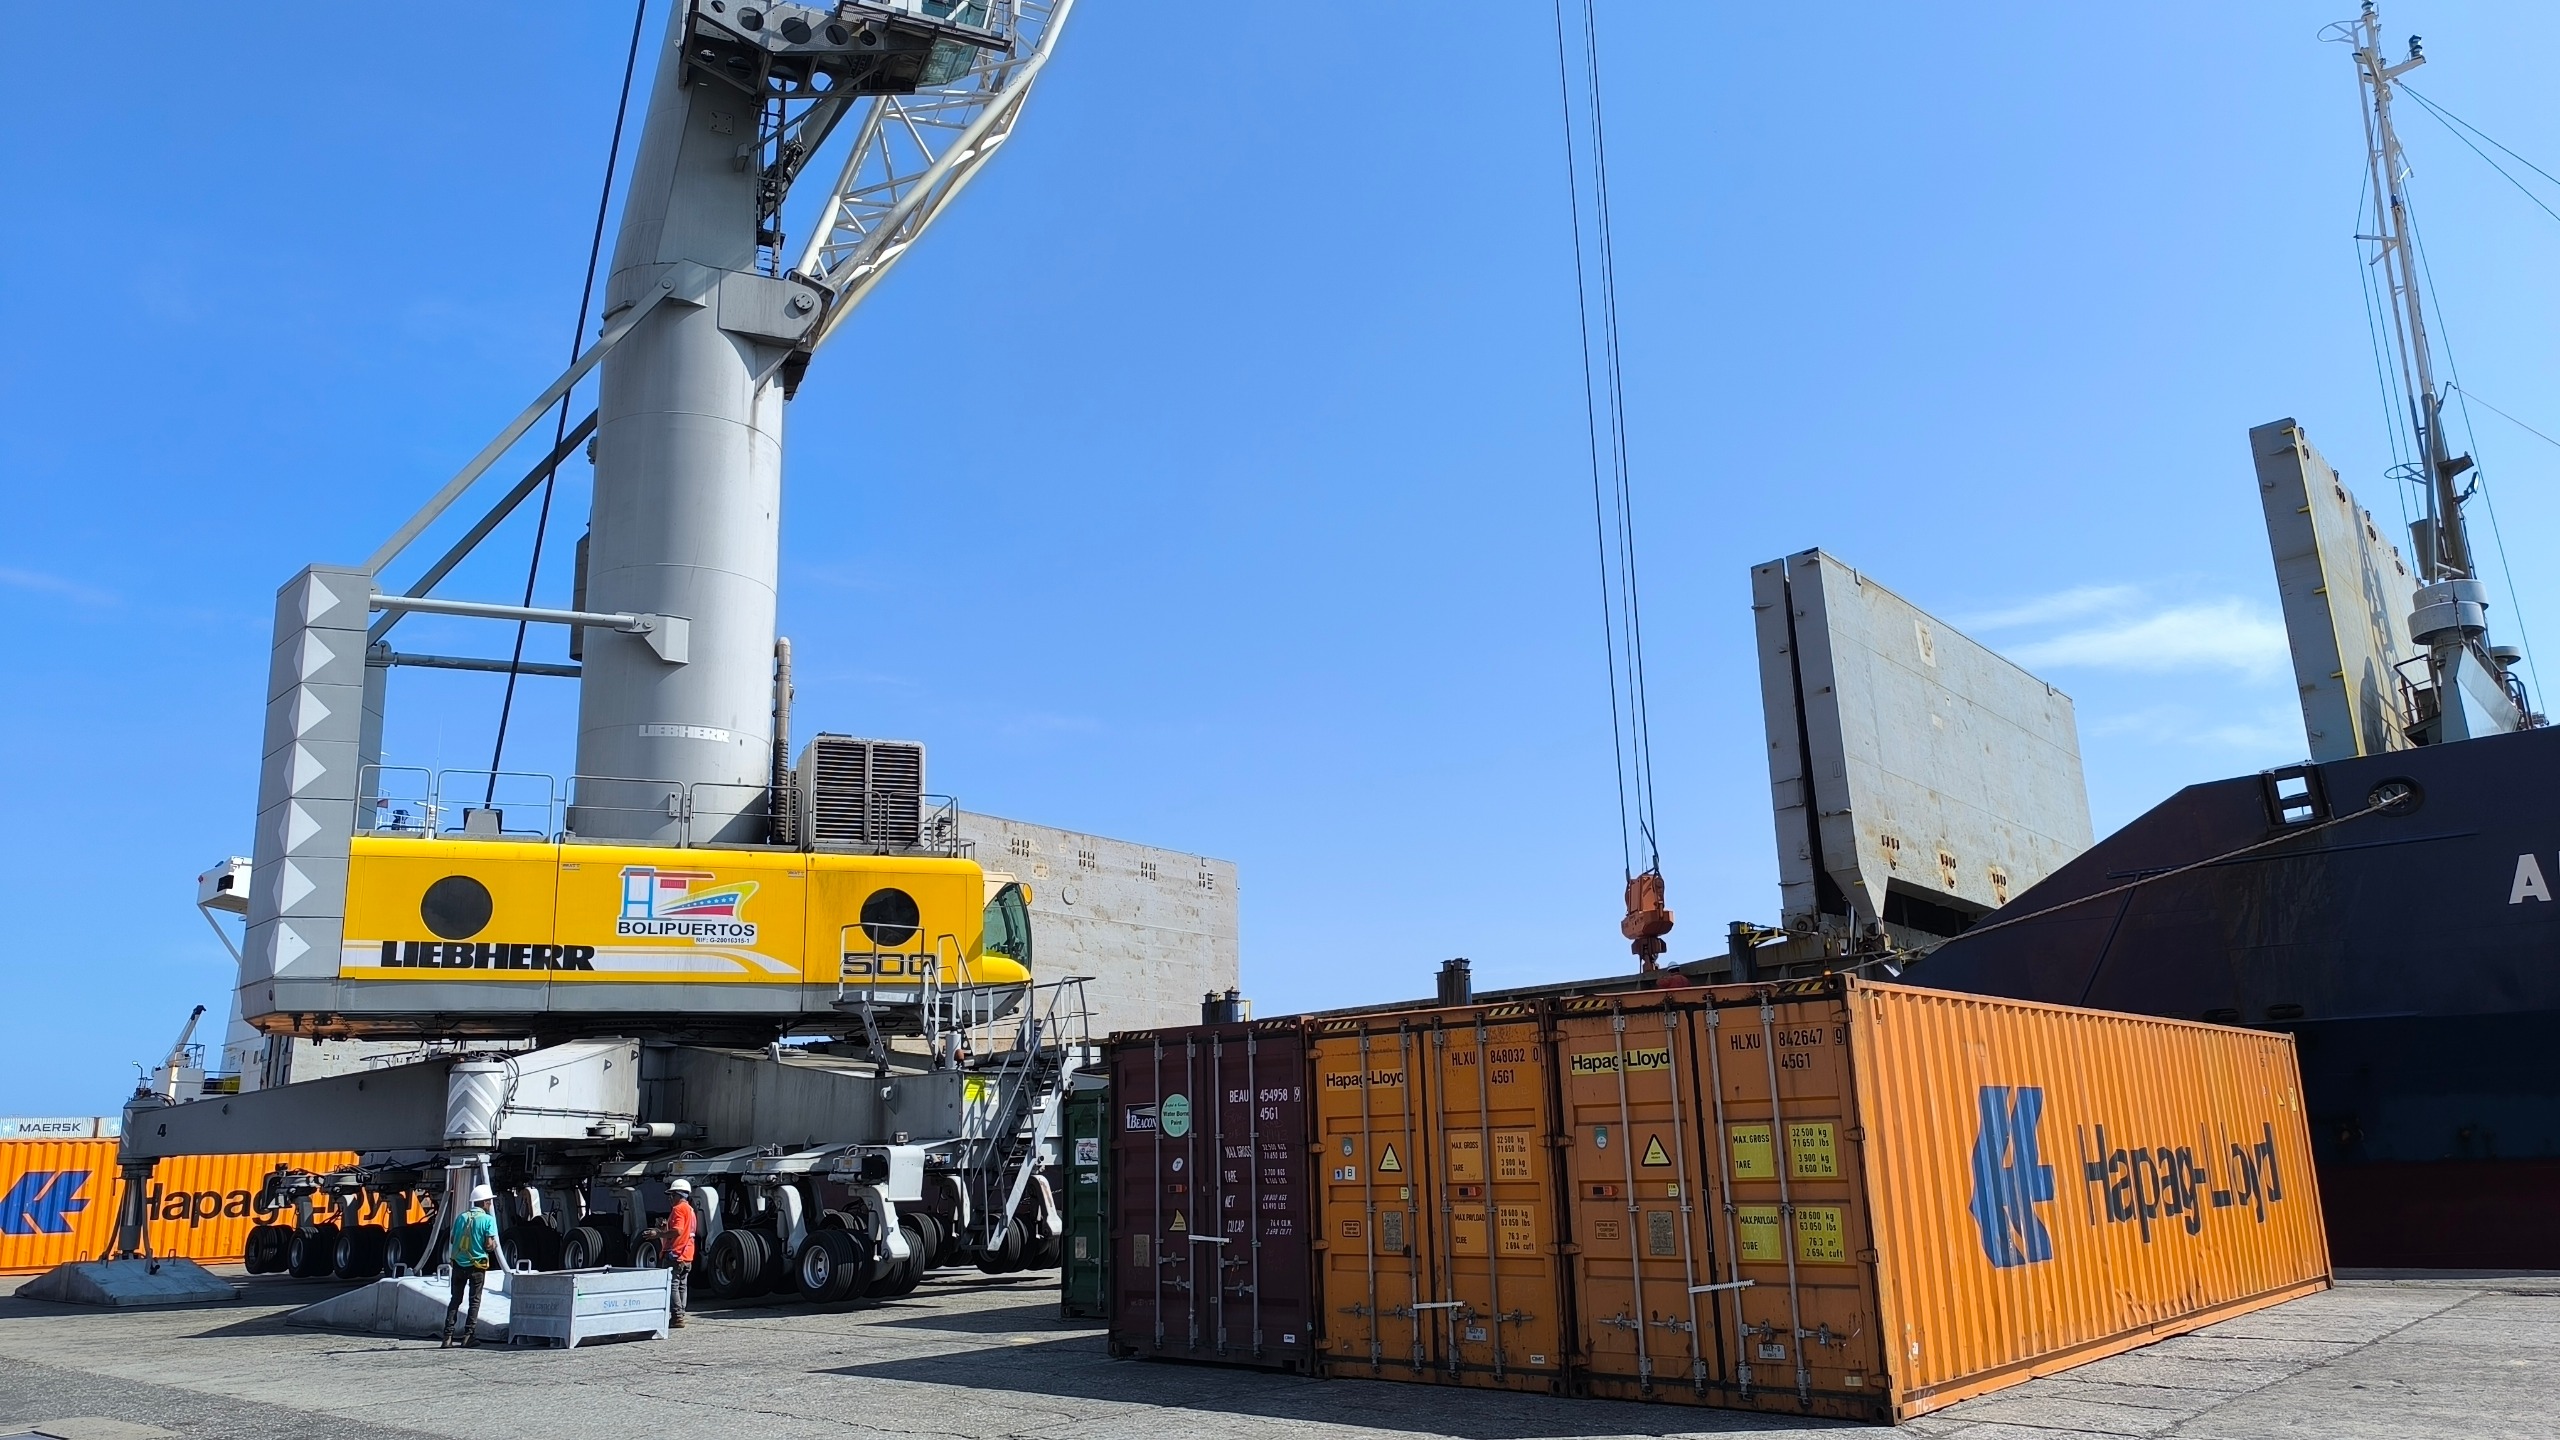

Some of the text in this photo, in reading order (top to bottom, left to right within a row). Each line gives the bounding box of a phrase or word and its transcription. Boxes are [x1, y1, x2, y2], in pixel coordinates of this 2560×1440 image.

[638, 724, 730, 743] LIEBHERR
[618, 922, 755, 937] BOLIPUERTOS
[381, 941, 595, 970] LIEBHERR
[842, 952, 937, 976] 500
[1730, 1028, 1843, 1050] HLXU 842647 9
[1451, 1047, 1539, 1066] HLXU 848032 0
[1781, 1053, 1811, 1070] 45G1
[1491, 1070, 1515, 1084] 45G1
[1229, 1087, 1301, 1103] BEAU 454958 9
[1260, 1107, 1279, 1120] 45G1
[19, 1122, 82, 1132] MAERSK
[156, 1124, 167, 1137] 4
[1792, 1127, 1827, 1138] 32 500 kg
[1517, 1136, 1525, 1145] kg
[1793, 1138, 1830, 1148] 71 650 lbs
[1518, 1158, 1526, 1167] kg
[1820, 1153, 1830, 1163] kg
[1453, 1164, 1464, 1172] TARE
[1735, 1160, 1751, 1169] TARE
[1821, 1164, 1832, 1173] lbs
[1521, 1209, 1529, 1219] kg
[1799, 1211, 1835, 1222] 28 600 kg
[1799, 1222, 1837, 1231] 63 050 lbs
[1742, 1241, 1759, 1250] CUBE
[1809, 1237, 1824, 1247] 76.3
[1811, 1248, 1825, 1257] 694
